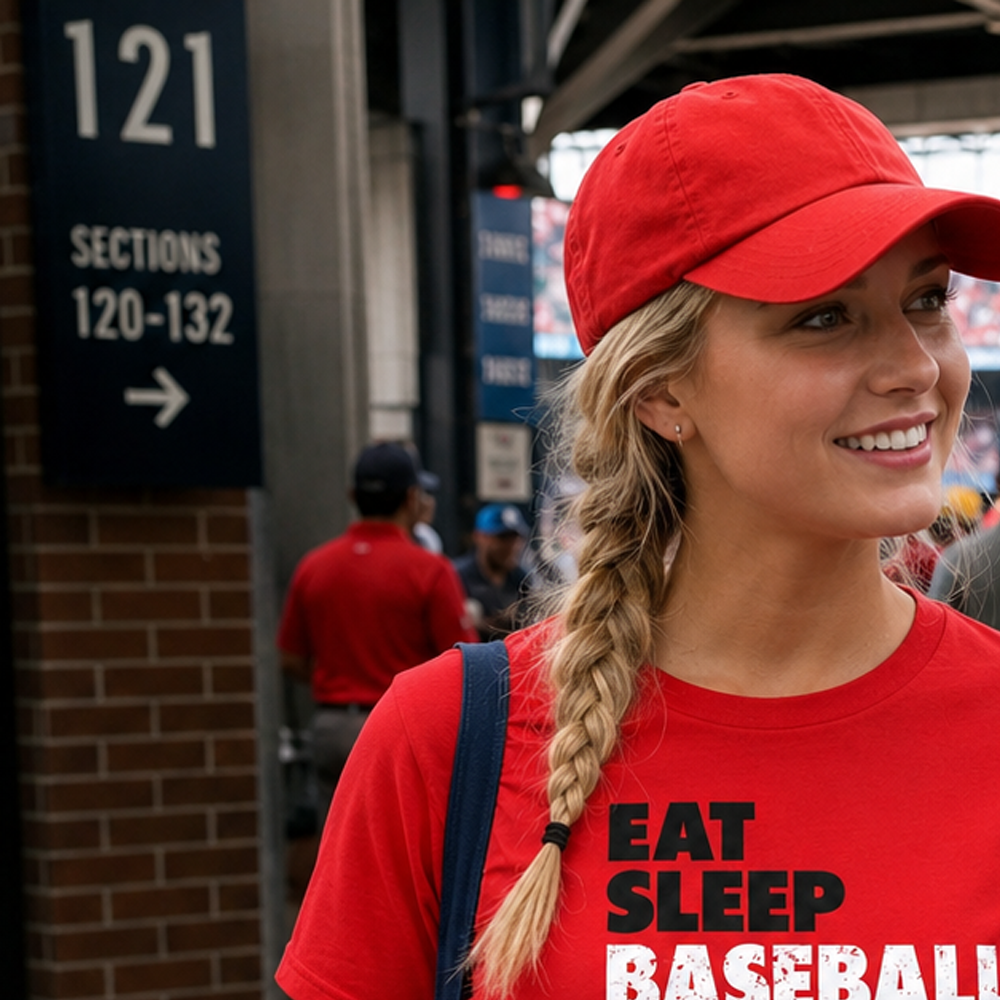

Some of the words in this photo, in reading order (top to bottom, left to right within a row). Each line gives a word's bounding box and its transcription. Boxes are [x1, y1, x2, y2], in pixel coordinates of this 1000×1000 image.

[65, 20, 216, 148] 121
[71, 225, 221, 275] SECTIONS
[72, 287, 235, 345] 120-132
[608, 802, 756, 862] EAT
[606, 870, 845, 933] SLEEP
